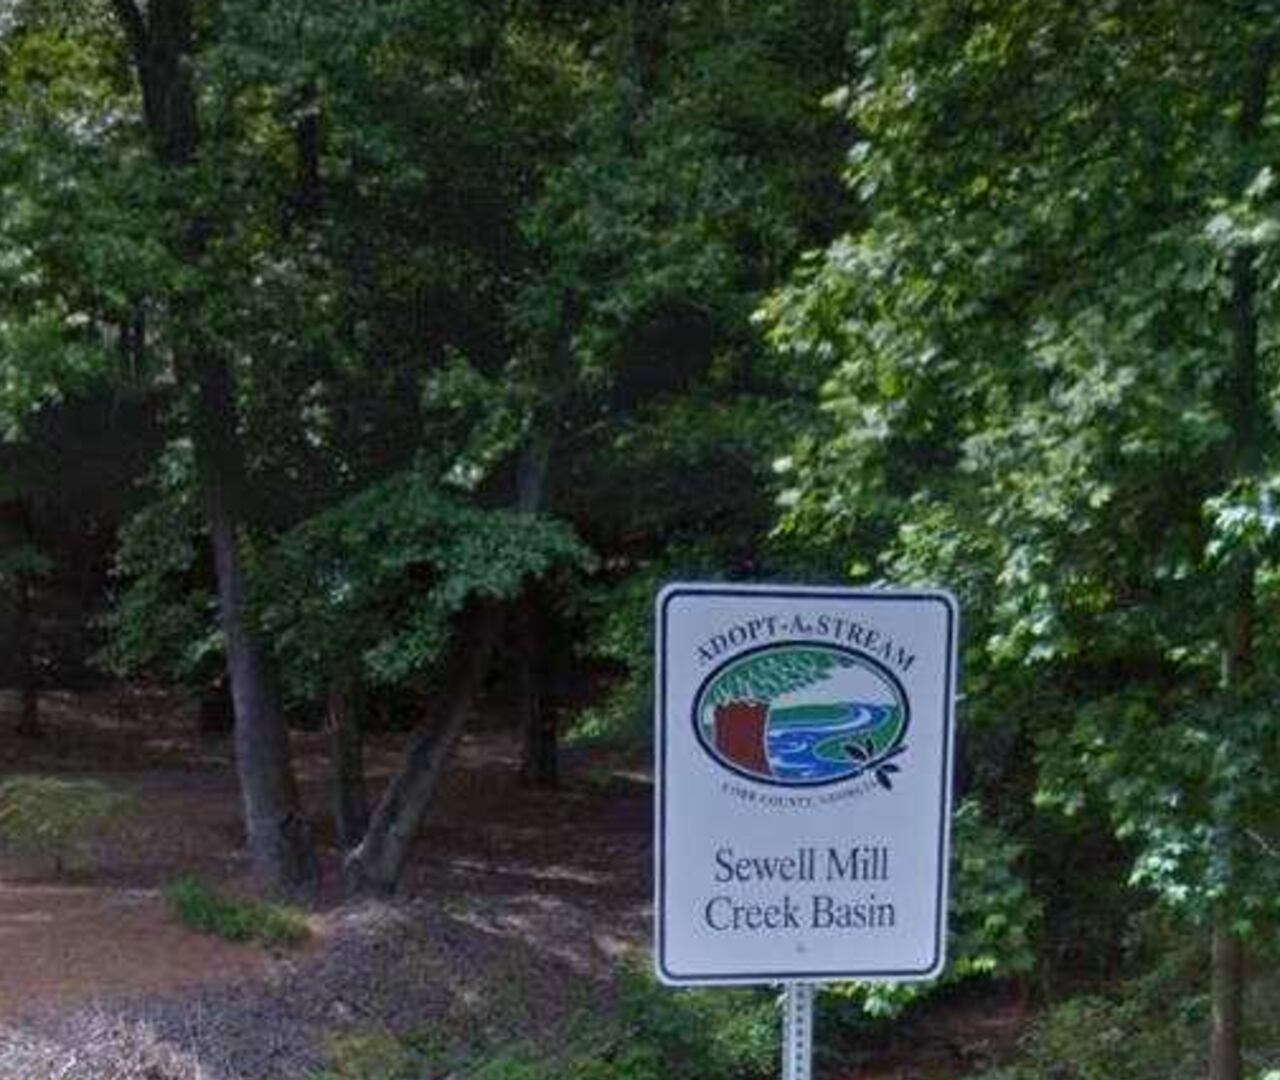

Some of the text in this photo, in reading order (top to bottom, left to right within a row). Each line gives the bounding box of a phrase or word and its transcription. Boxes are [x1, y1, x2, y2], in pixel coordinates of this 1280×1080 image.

[714, 846, 889, 883] Sewell Mill
[704, 894, 896, 932] Creek Basin
